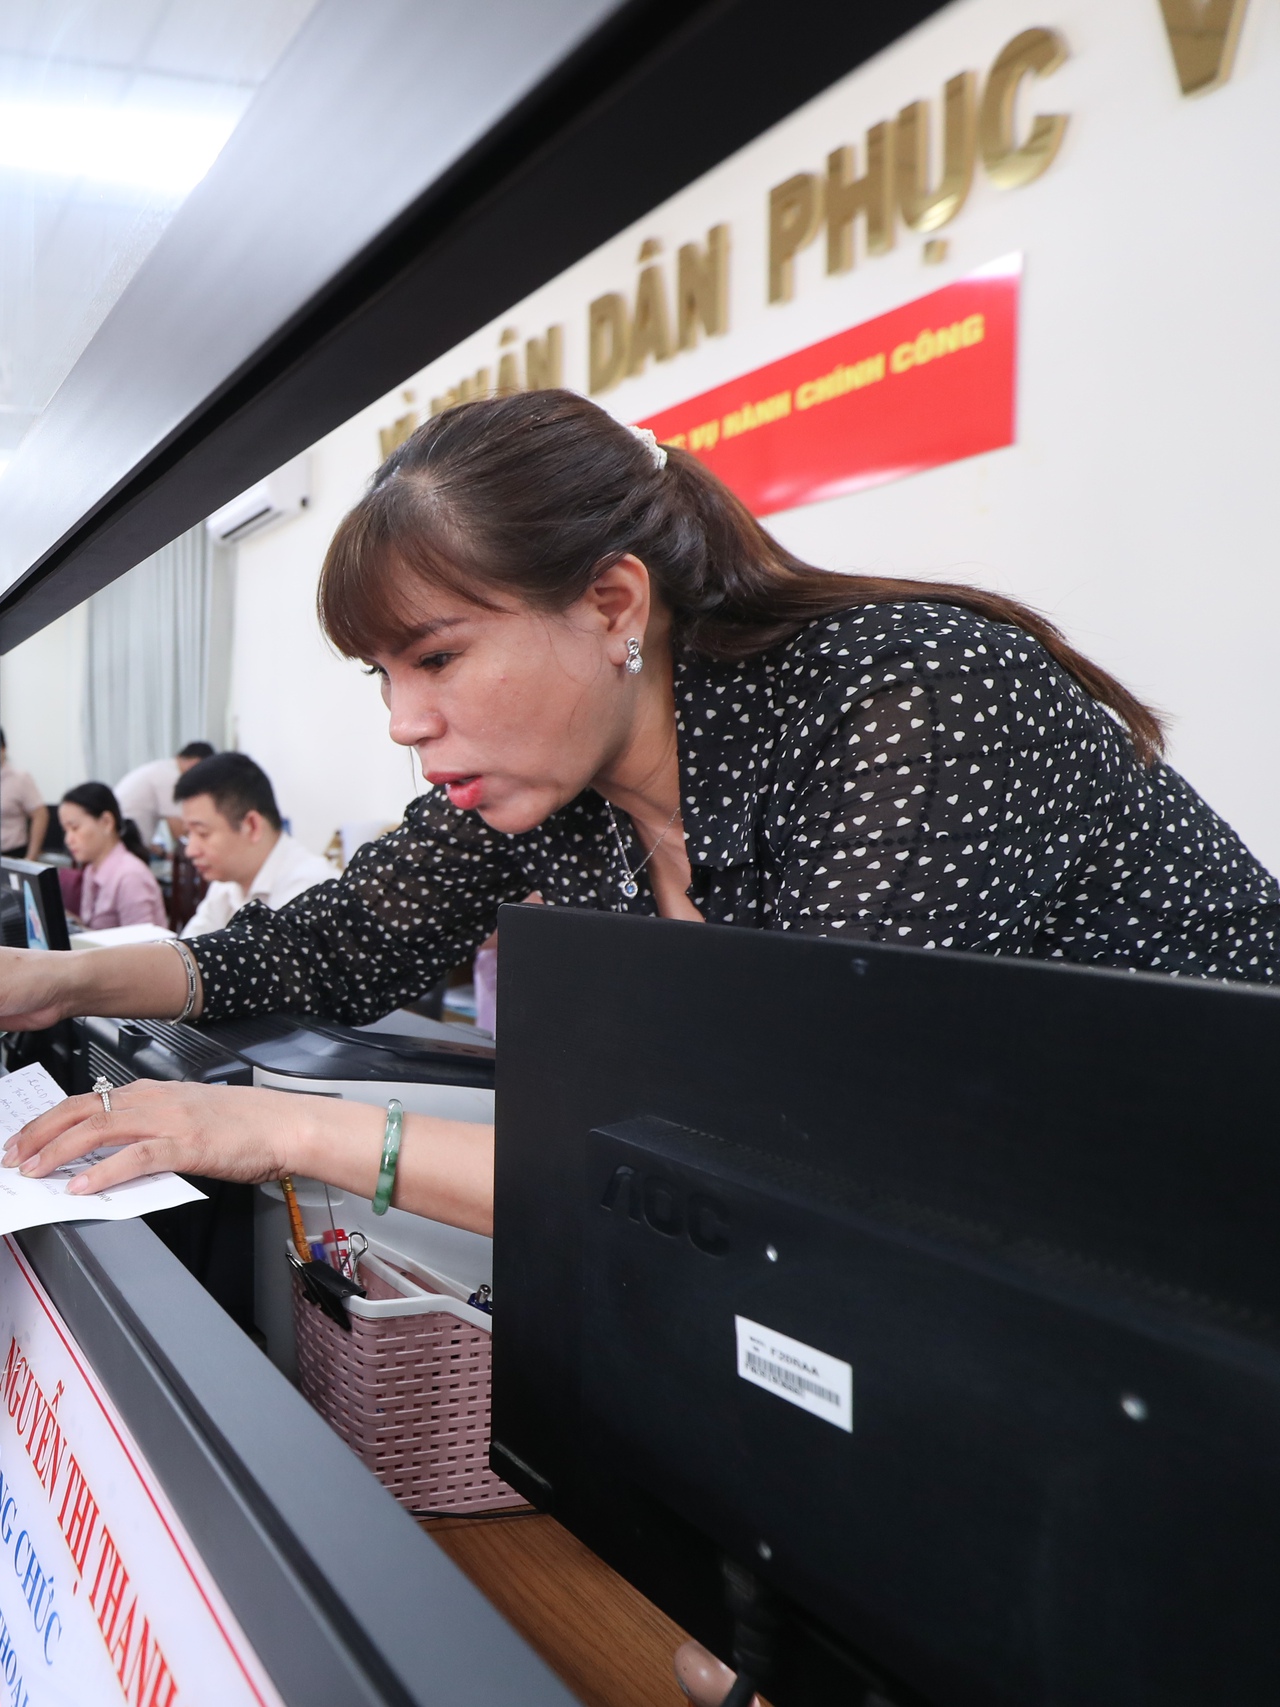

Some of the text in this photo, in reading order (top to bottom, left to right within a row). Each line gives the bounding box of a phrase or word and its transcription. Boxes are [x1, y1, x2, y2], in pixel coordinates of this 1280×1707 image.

[588, 226, 732, 396] DÂN
[768, 27, 1070, 306] PHỤC
[722, 391, 792, 440] HÀNH
[794, 354, 885, 411] CHÍNH
[890, 314, 986, 374] CÔNG
[600, 1166, 732, 1260] AOC
[57, 1453, 100, 1596] THỊ
[14, 1530, 62, 1665] CHỨC
